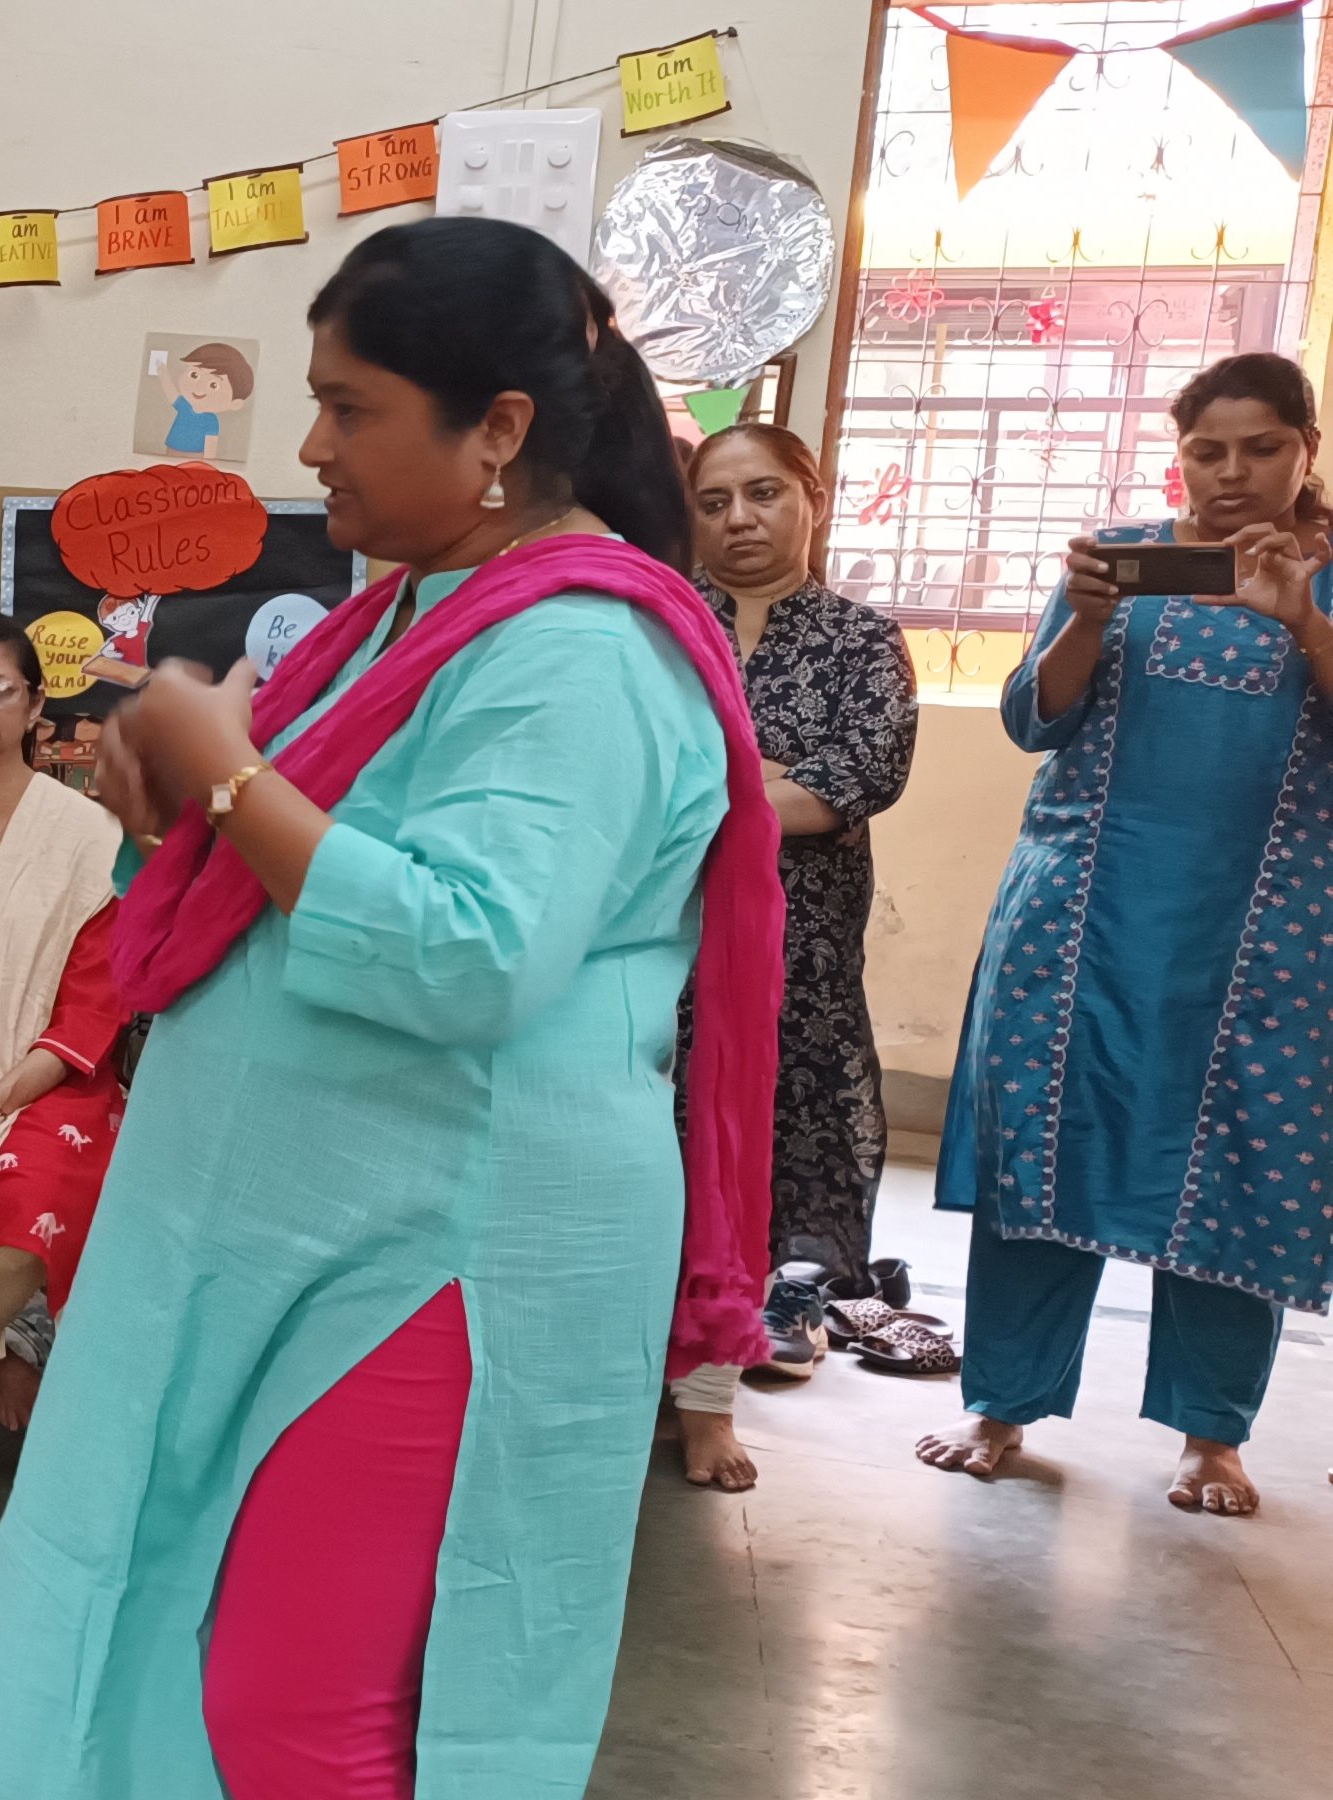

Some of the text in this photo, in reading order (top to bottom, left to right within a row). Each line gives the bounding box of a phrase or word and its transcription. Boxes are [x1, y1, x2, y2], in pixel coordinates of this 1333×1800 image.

[635, 56, 693, 81] I am
[625, 69, 717, 114] Worth It
[365, 138, 417, 158] I am
[347, 157, 432, 190] STRONG
[228, 181, 276, 201] I am
[114, 204, 168, 225] I am
[12, 222, 38, 239] am
[107, 226, 174, 255] BRAVE
[66, 479, 240, 531] Classroom
[107, 526, 211, 575] Rules
[33, 624, 89, 650] Raise
[266, 614, 298, 640] Be
[45, 650, 91, 667] your
